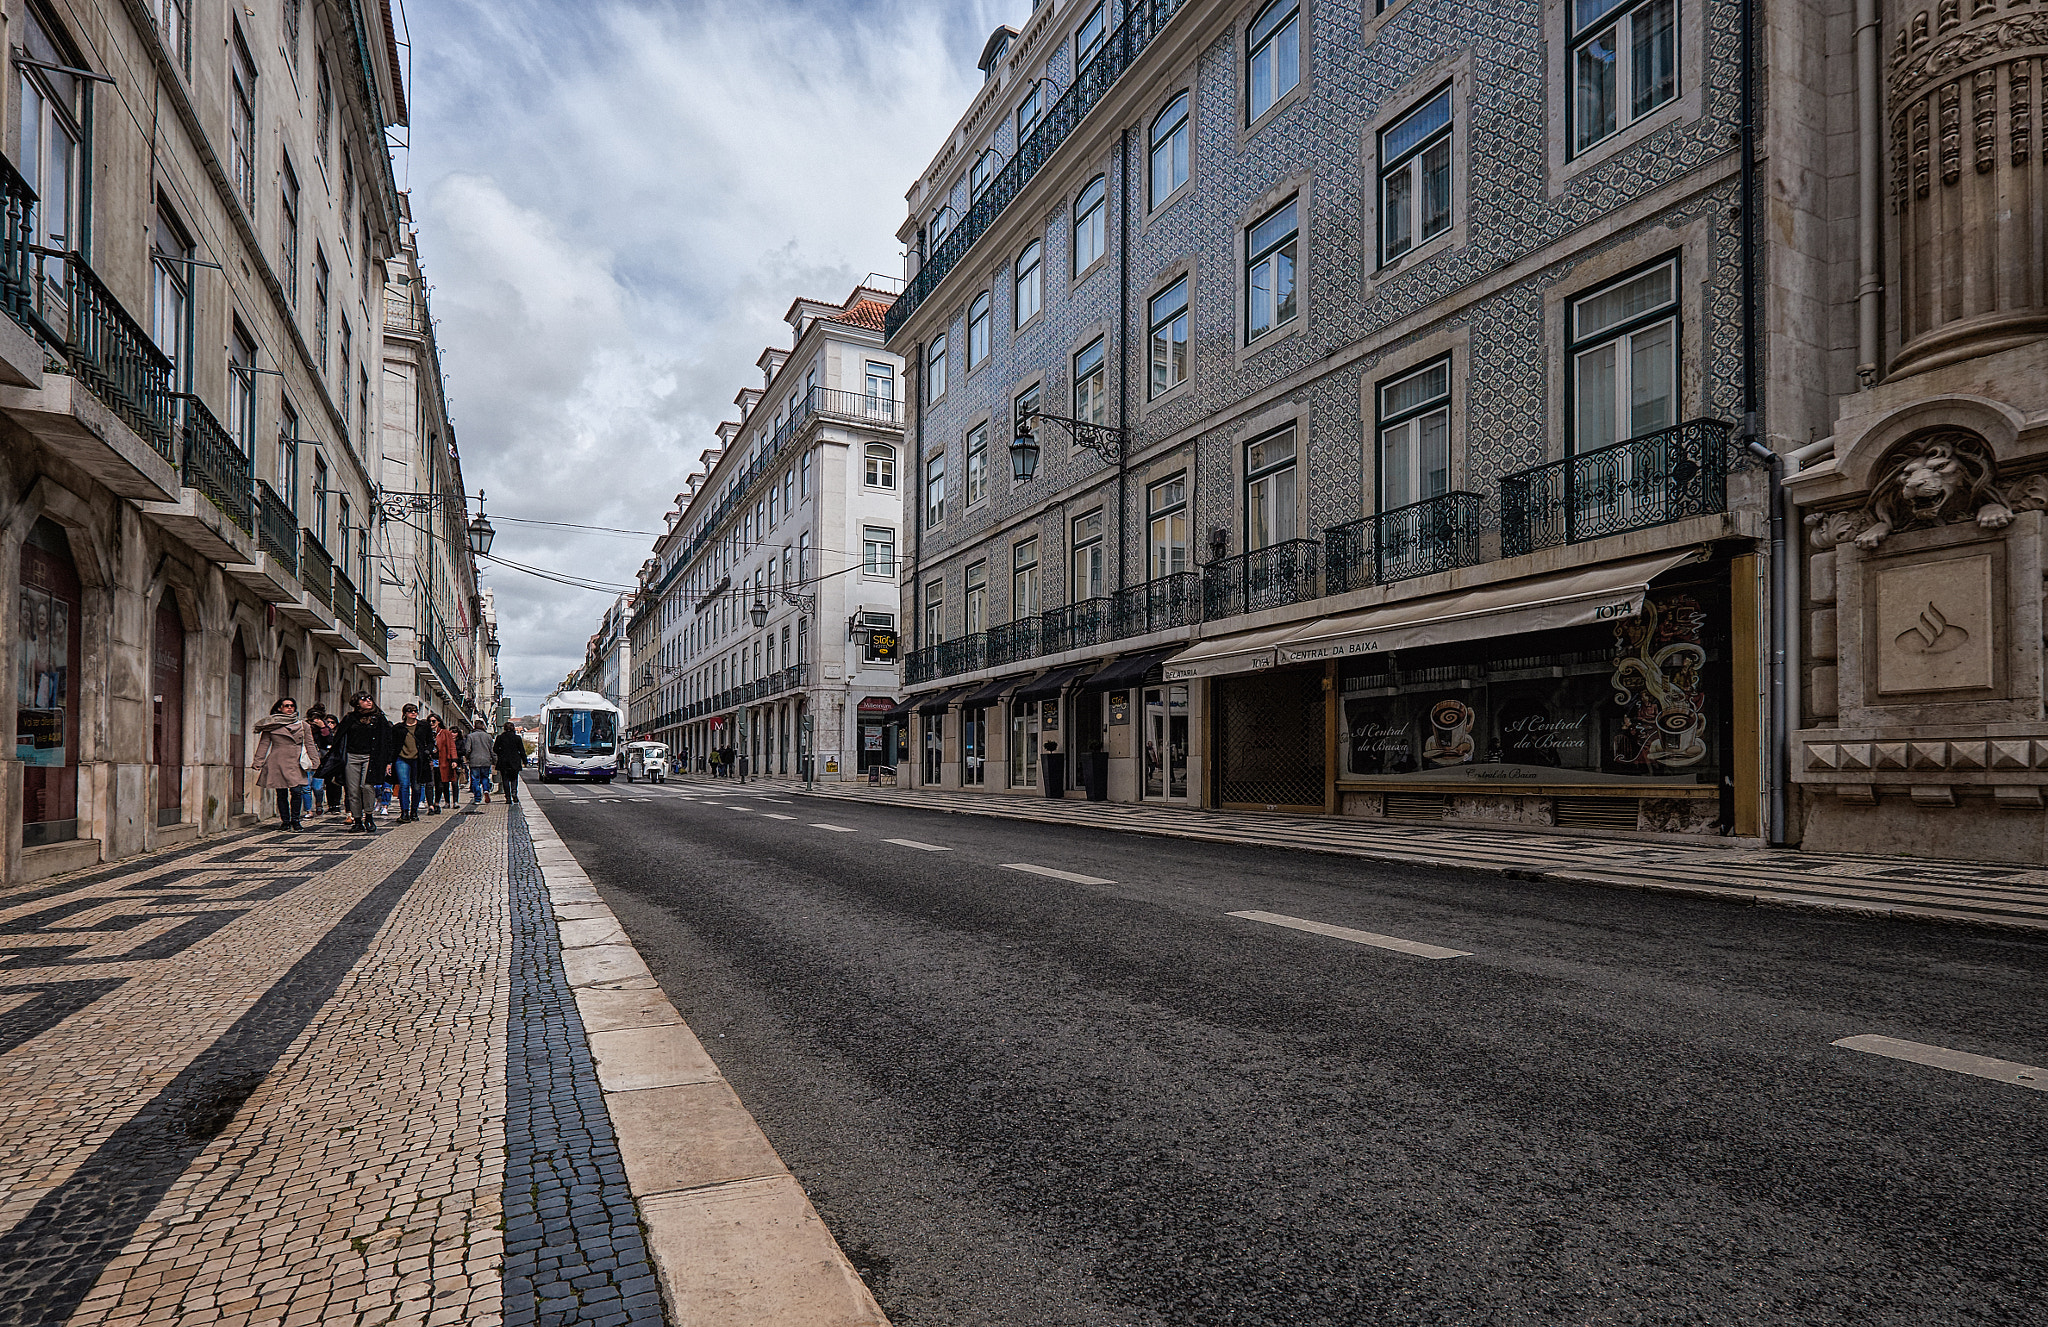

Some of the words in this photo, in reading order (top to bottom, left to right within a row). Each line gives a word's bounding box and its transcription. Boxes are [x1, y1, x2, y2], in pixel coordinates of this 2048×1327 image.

[1594, 601, 1633, 619] TOFA
[1281, 652, 1287, 661] A
[1290, 648, 1328, 660] CENTRAL
[1333, 646, 1345, 655] DA
[1349, 641, 1378, 653] BAIXA
[1252, 658, 1270, 668] TOFA
[714, 721, 724, 731] M
[1351, 723, 1369, 738] A
[1368, 722, 1409, 737] Central
[1504, 716, 1529, 733] A
[1528, 713, 1587, 732] Central
[1357, 739, 1371, 752] da
[1372, 737, 1408, 752] Baixa
[1513, 733, 1532, 749] da
[1534, 731, 1586, 749] Baixa
